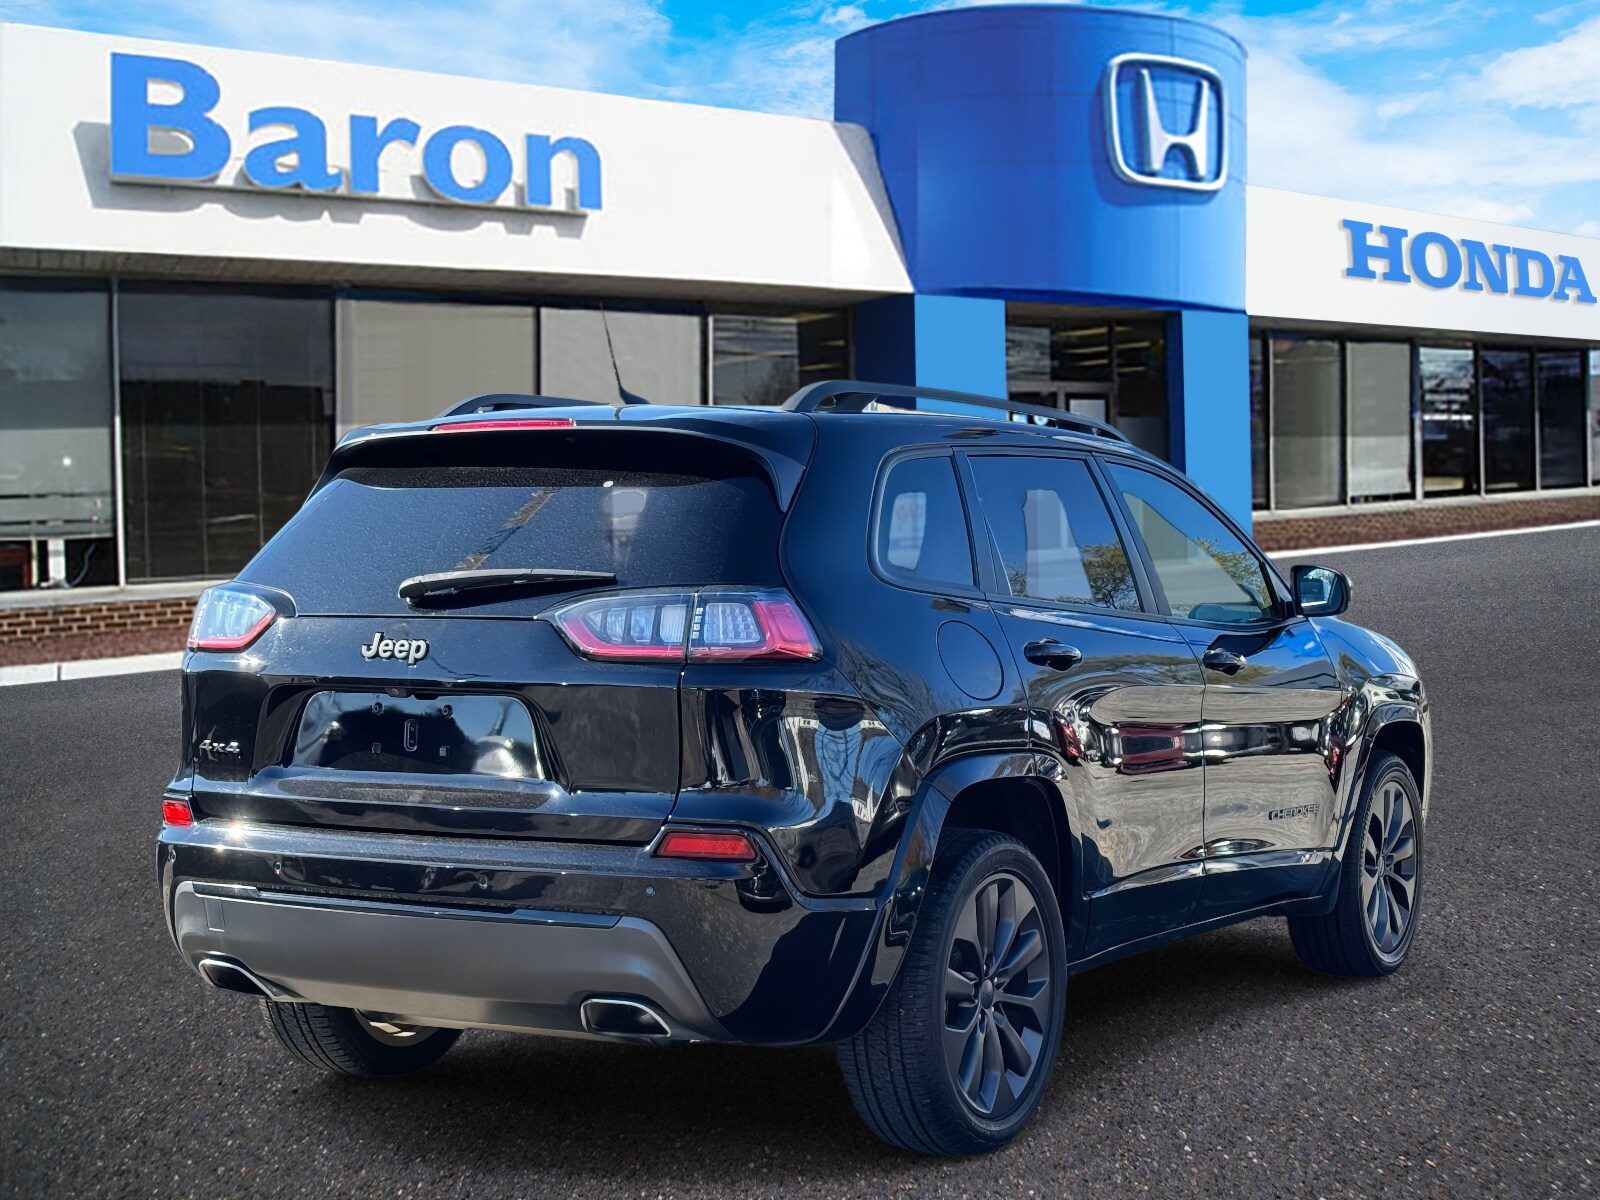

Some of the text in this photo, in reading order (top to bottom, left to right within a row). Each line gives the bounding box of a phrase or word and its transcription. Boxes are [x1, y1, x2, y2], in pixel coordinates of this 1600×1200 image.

[110, 52, 602, 211] Baron
[1342, 218, 1598, 304] HONDA
[361, 632, 429, 666] Jeep
[1269, 803, 1320, 820] CHEROKEE
